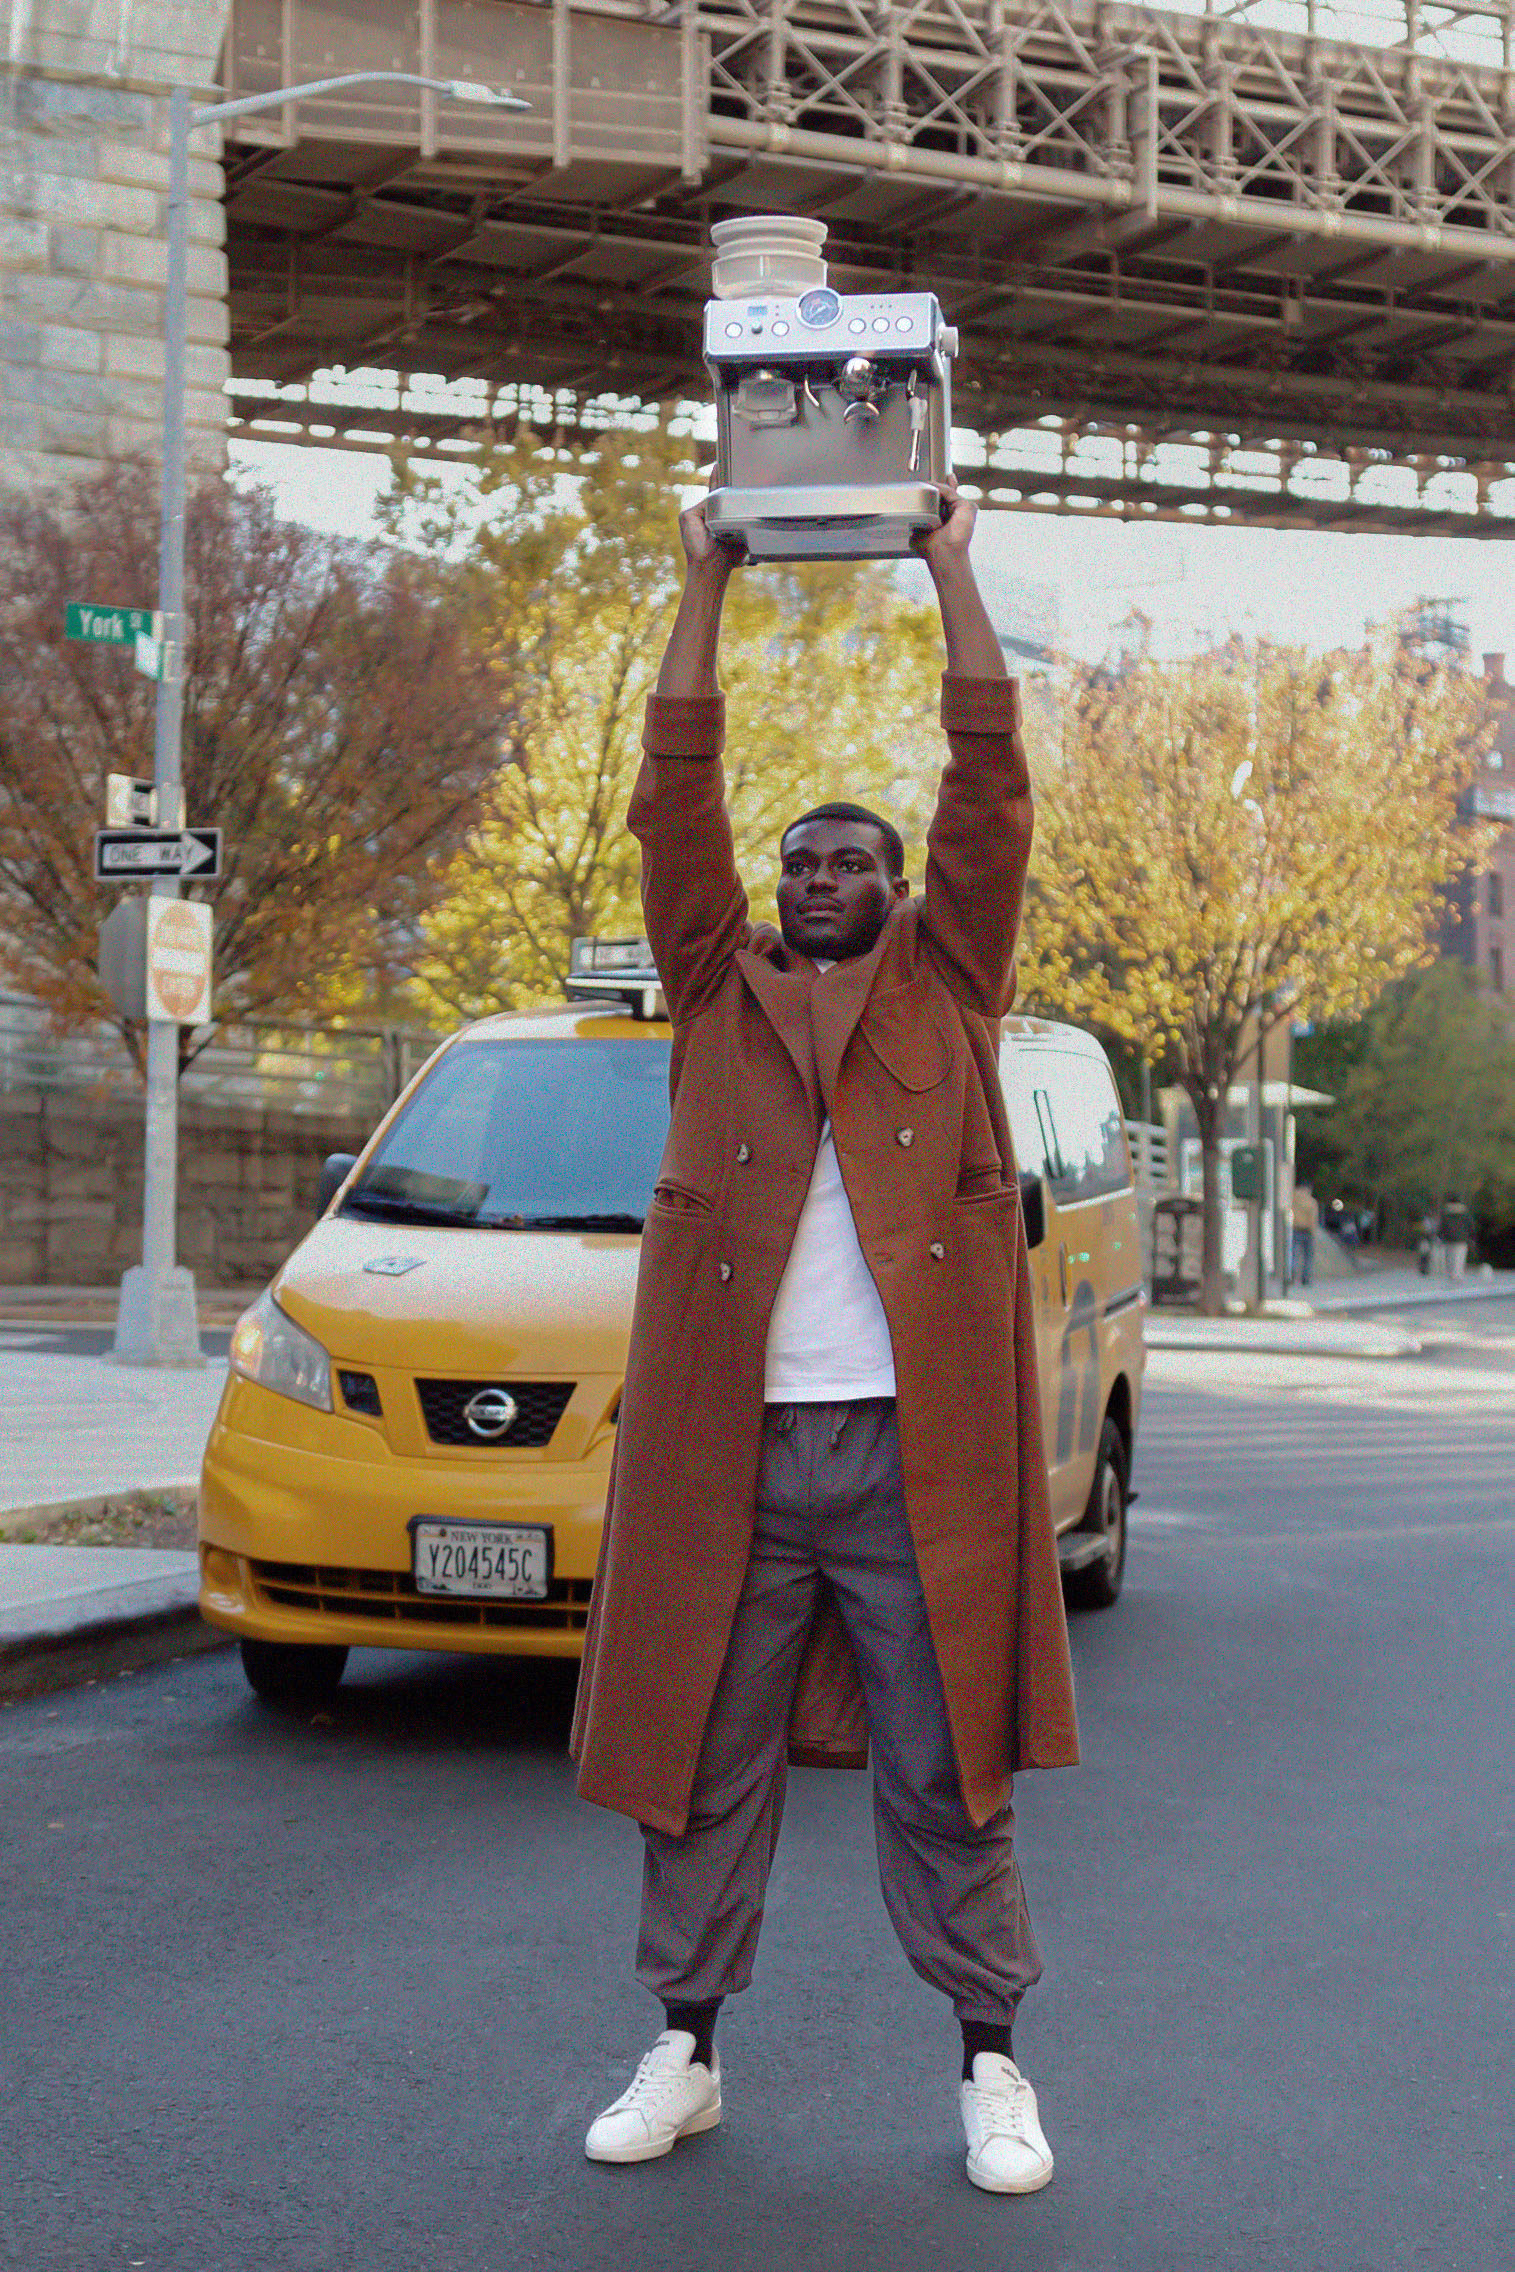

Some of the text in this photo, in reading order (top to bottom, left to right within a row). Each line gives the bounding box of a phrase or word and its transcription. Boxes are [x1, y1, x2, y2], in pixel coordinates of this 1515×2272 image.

[79, 609, 124, 639] York
[110, 843, 194, 863] ONE WAY
[451, 1531, 513, 1545] NEW YORK
[429, 1543, 532, 1582] Y204545C
